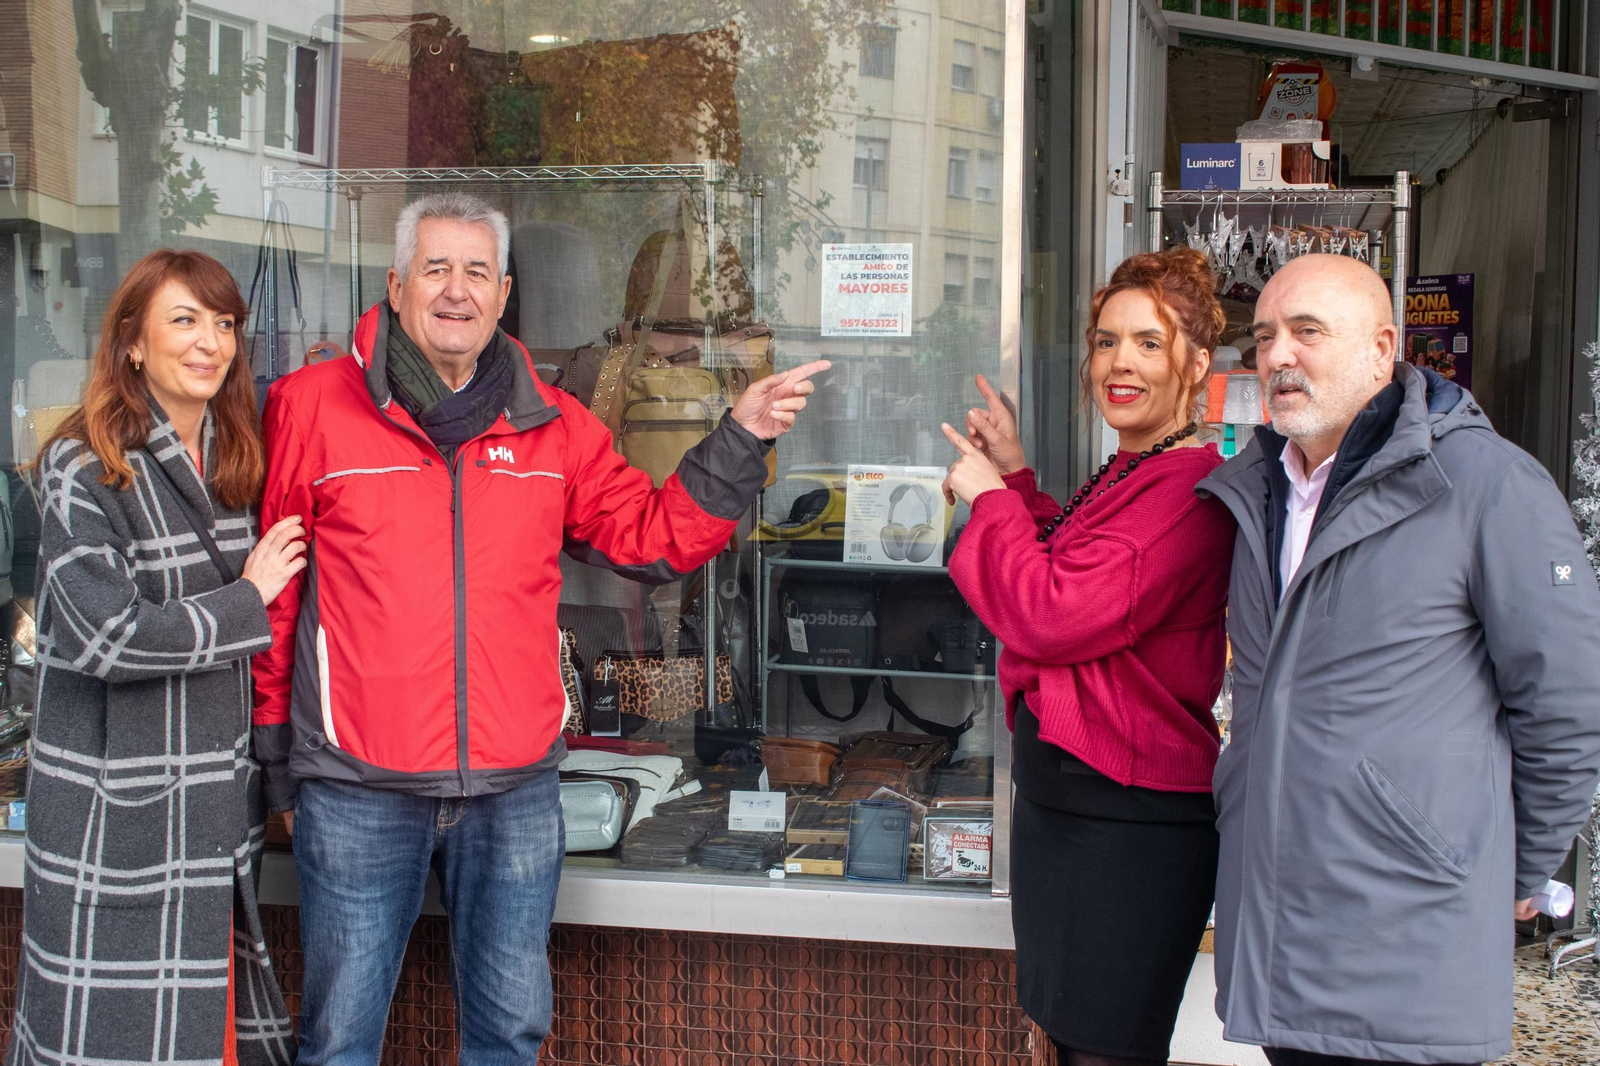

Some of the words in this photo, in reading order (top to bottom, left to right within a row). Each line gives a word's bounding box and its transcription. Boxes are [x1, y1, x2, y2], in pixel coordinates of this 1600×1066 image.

[1278, 86, 1311, 98] ZONE
[1187, 157, 1235, 168] Luminarc
[1258, 159, 1264, 167] 6
[826, 253, 909, 261] ESTABLECIMIENTO
[863, 263, 894, 271] AMIGO
[896, 263, 909, 271] DE
[838, 282, 909, 294] MAYORES
[1407, 285, 1426, 293] REGALA
[1405, 293, 1451, 311] DONA
[1404, 310, 1460, 326] UGUETES
[840, 318, 898, 328] 957453122
[488, 446, 515, 463] HH
[865, 472, 885, 480] ELCO
[953, 834, 989, 843] ALARMA
[953, 841, 989, 850] CONECTADA
